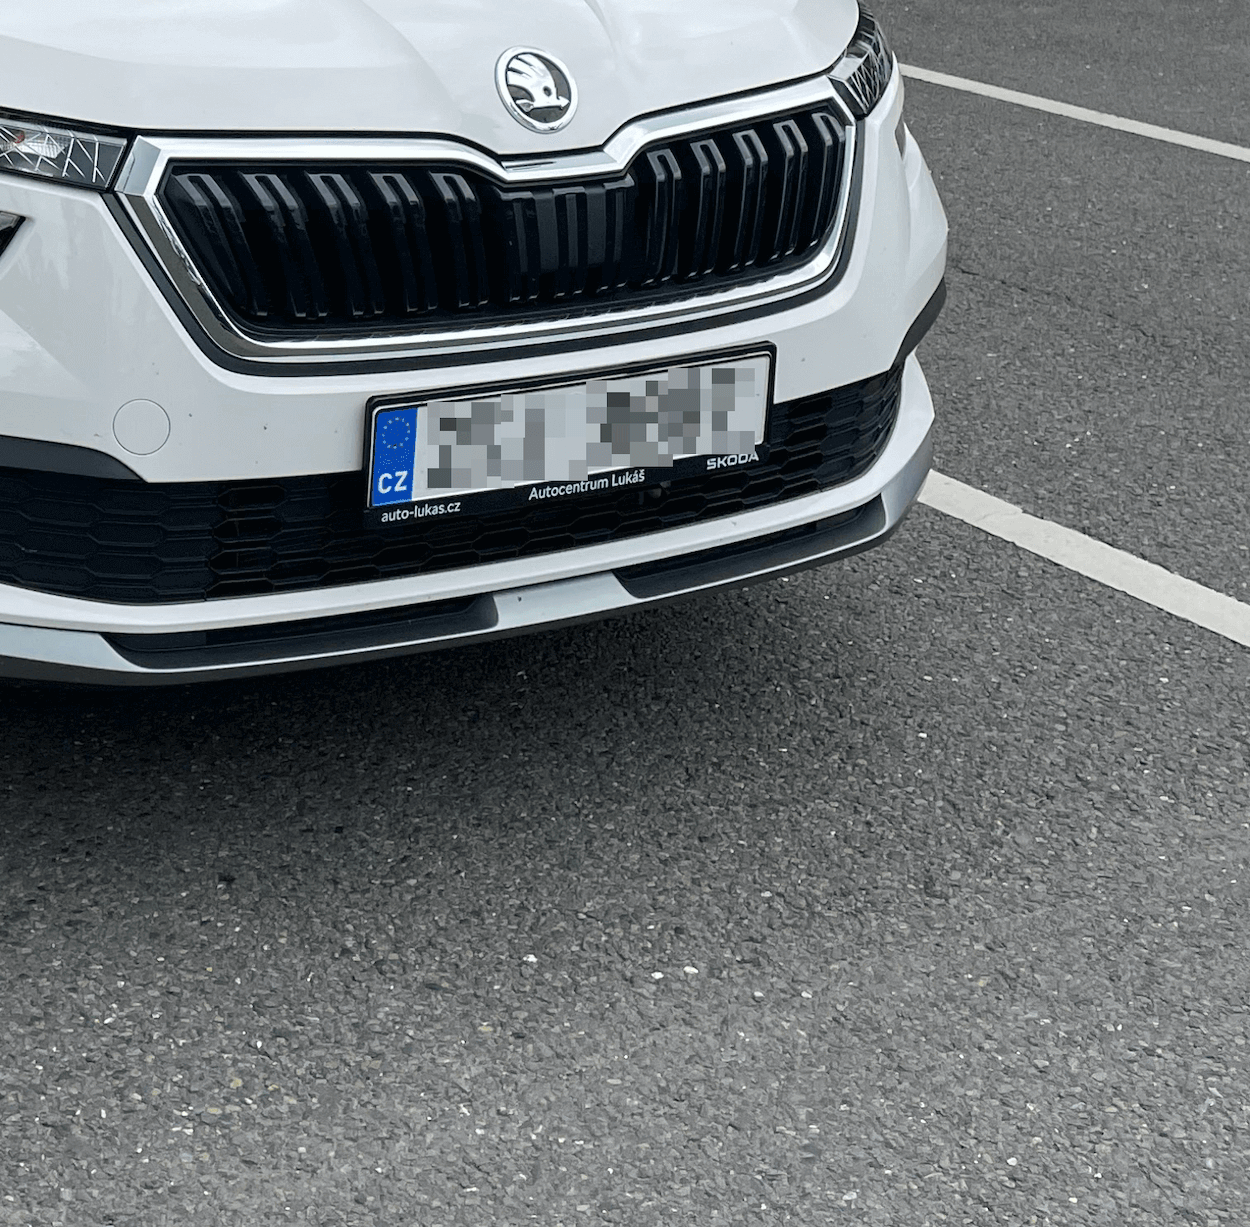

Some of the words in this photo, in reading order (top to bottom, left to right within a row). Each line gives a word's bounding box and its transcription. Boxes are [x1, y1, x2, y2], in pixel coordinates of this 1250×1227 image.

[377, 470, 408, 494] CZ
[528, 478, 609, 501] Autocentrum
[611, 469, 645, 487] Lukáš
[381, 502, 461, 523] auto-lukas.cz
